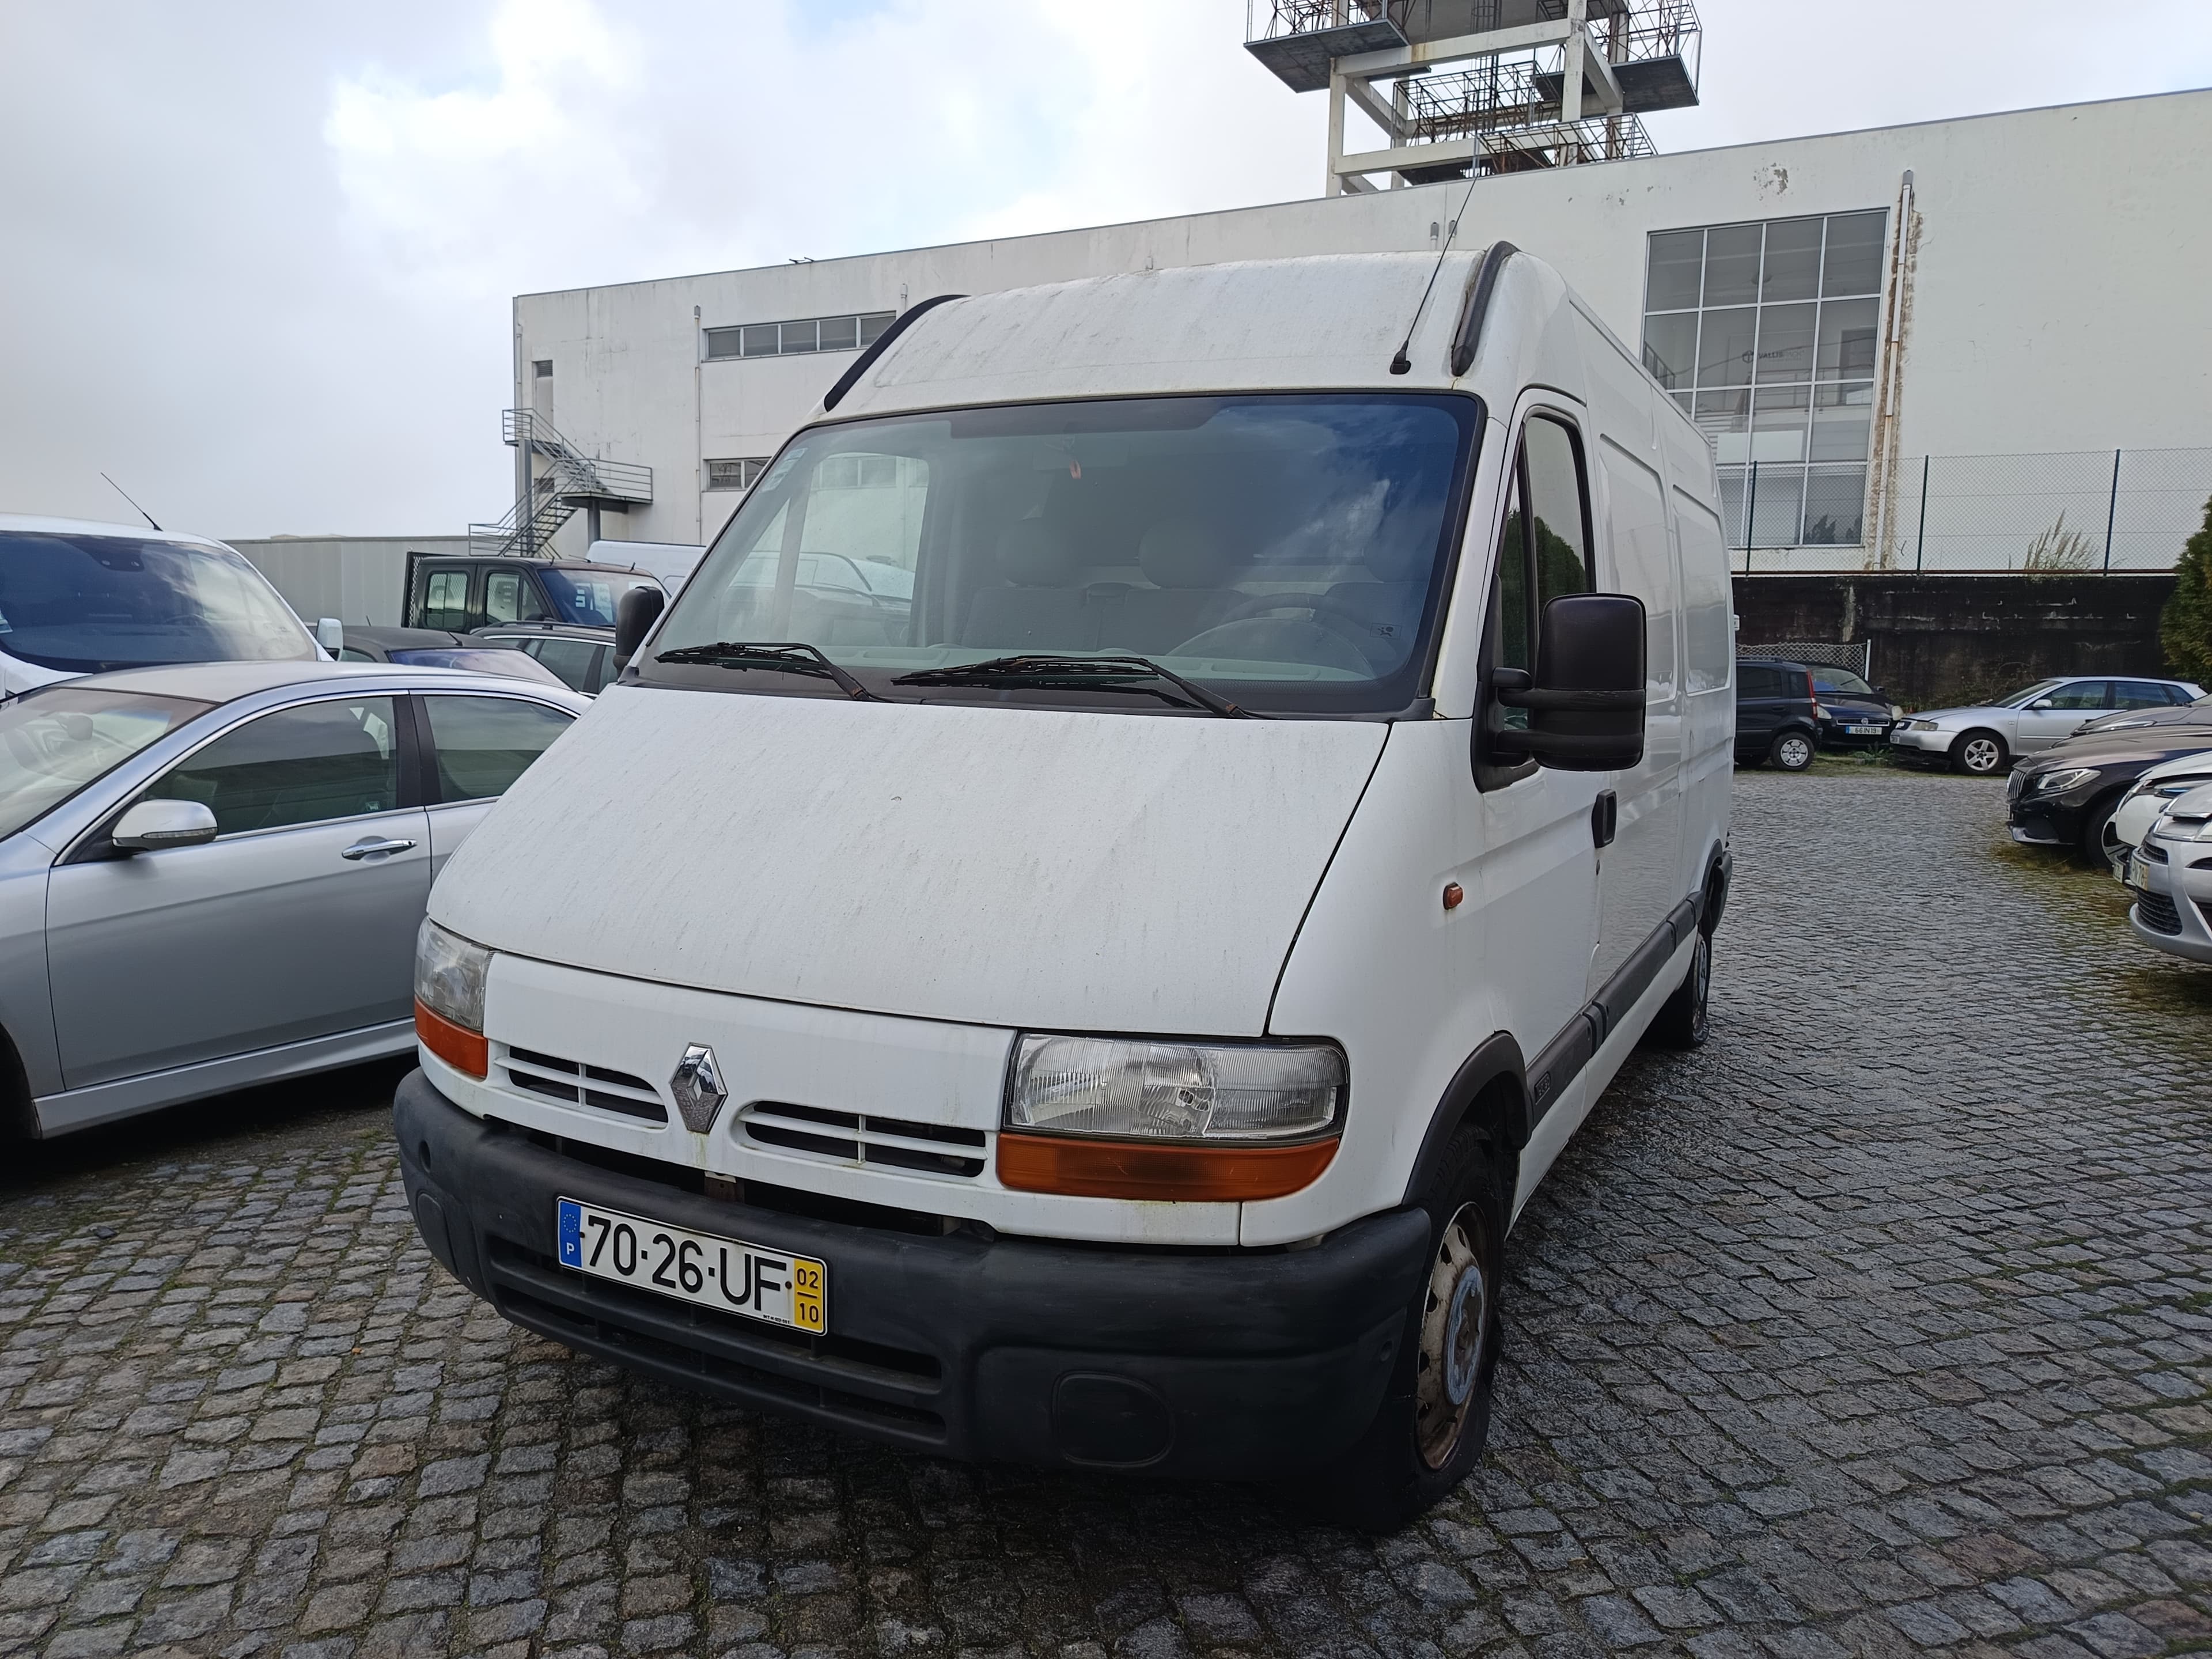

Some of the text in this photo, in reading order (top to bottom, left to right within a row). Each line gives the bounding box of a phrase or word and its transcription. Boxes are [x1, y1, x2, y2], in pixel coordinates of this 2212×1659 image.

[566, 1242, 575, 1255] P
[797, 1268, 819, 1289] 02
[799, 1302, 819, 1323] 10
